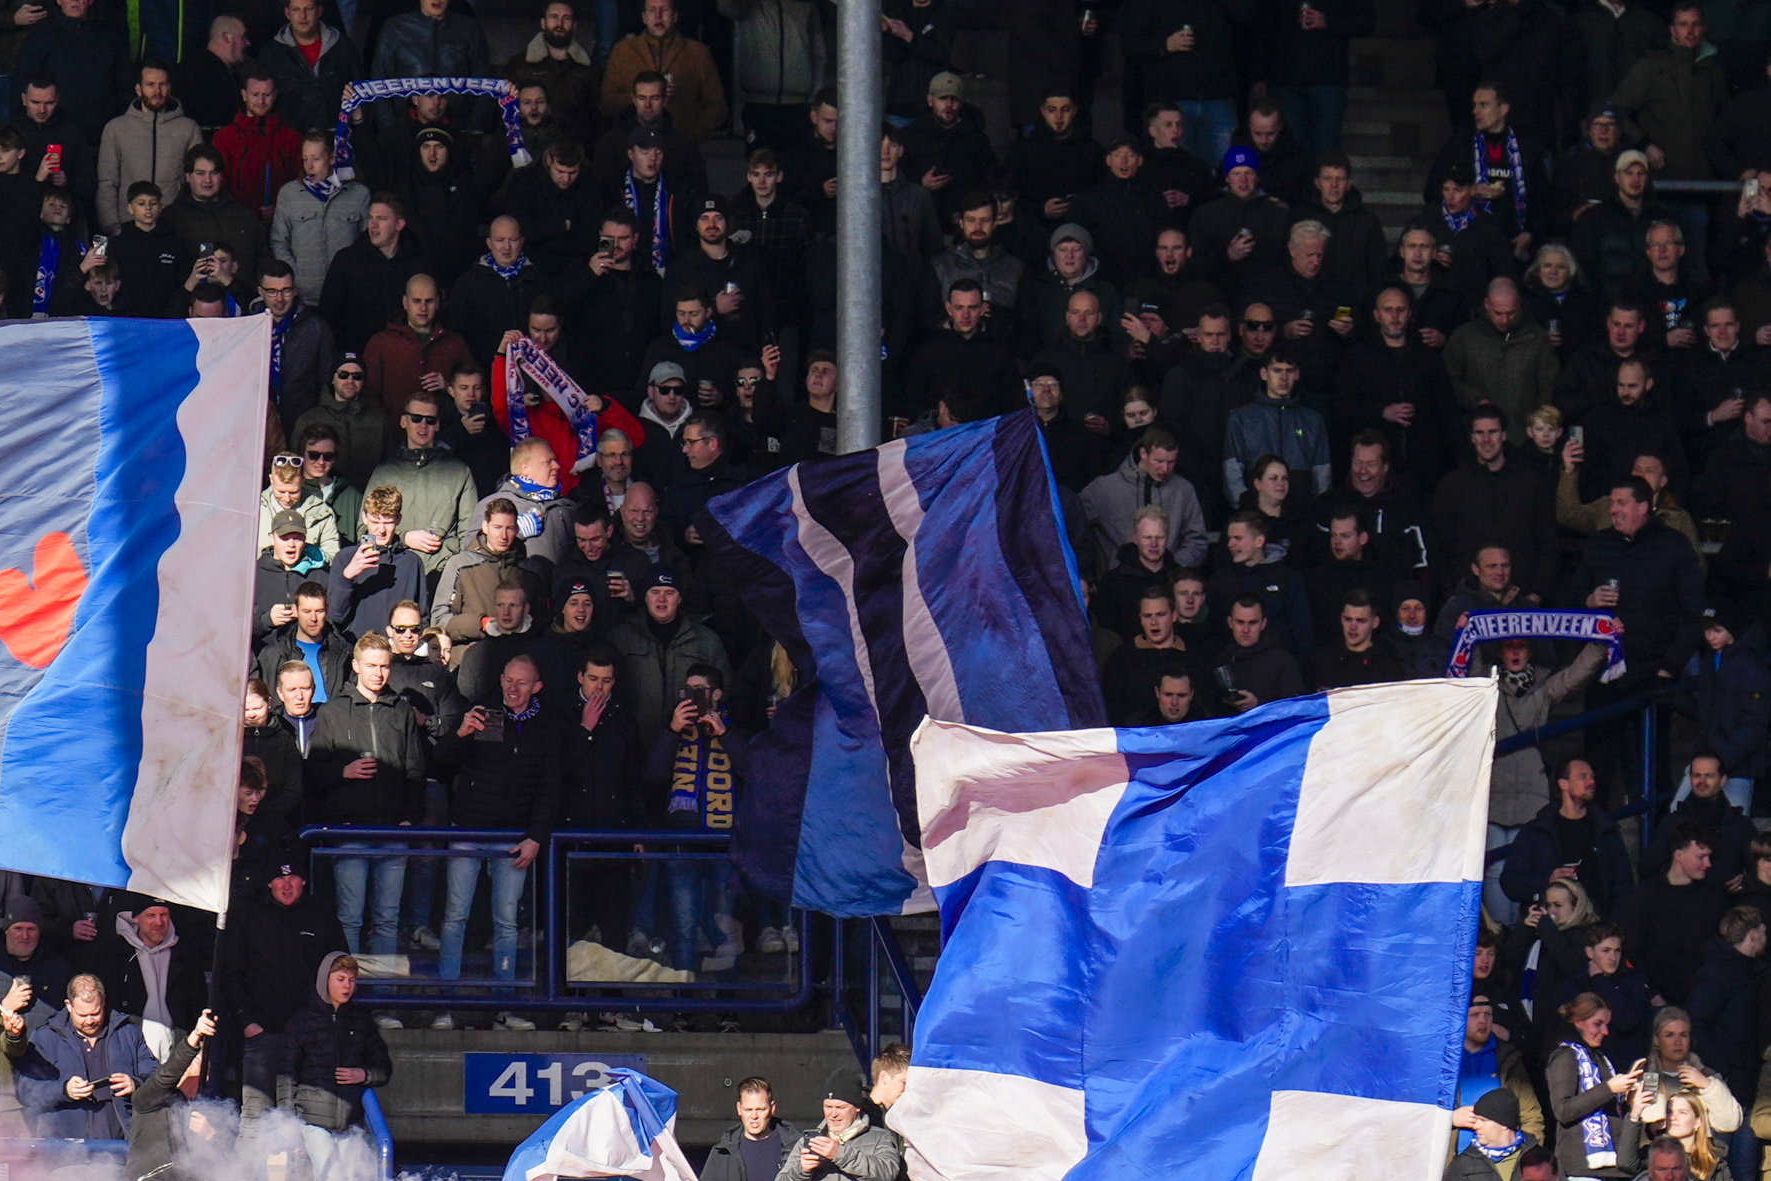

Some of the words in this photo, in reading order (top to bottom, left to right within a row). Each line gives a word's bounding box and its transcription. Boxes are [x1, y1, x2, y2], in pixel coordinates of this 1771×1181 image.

[354, 77, 511, 98] HEERENVEEN
[1477, 613, 1596, 638] HEERENVEEN
[488, 1061, 612, 1105] 413
